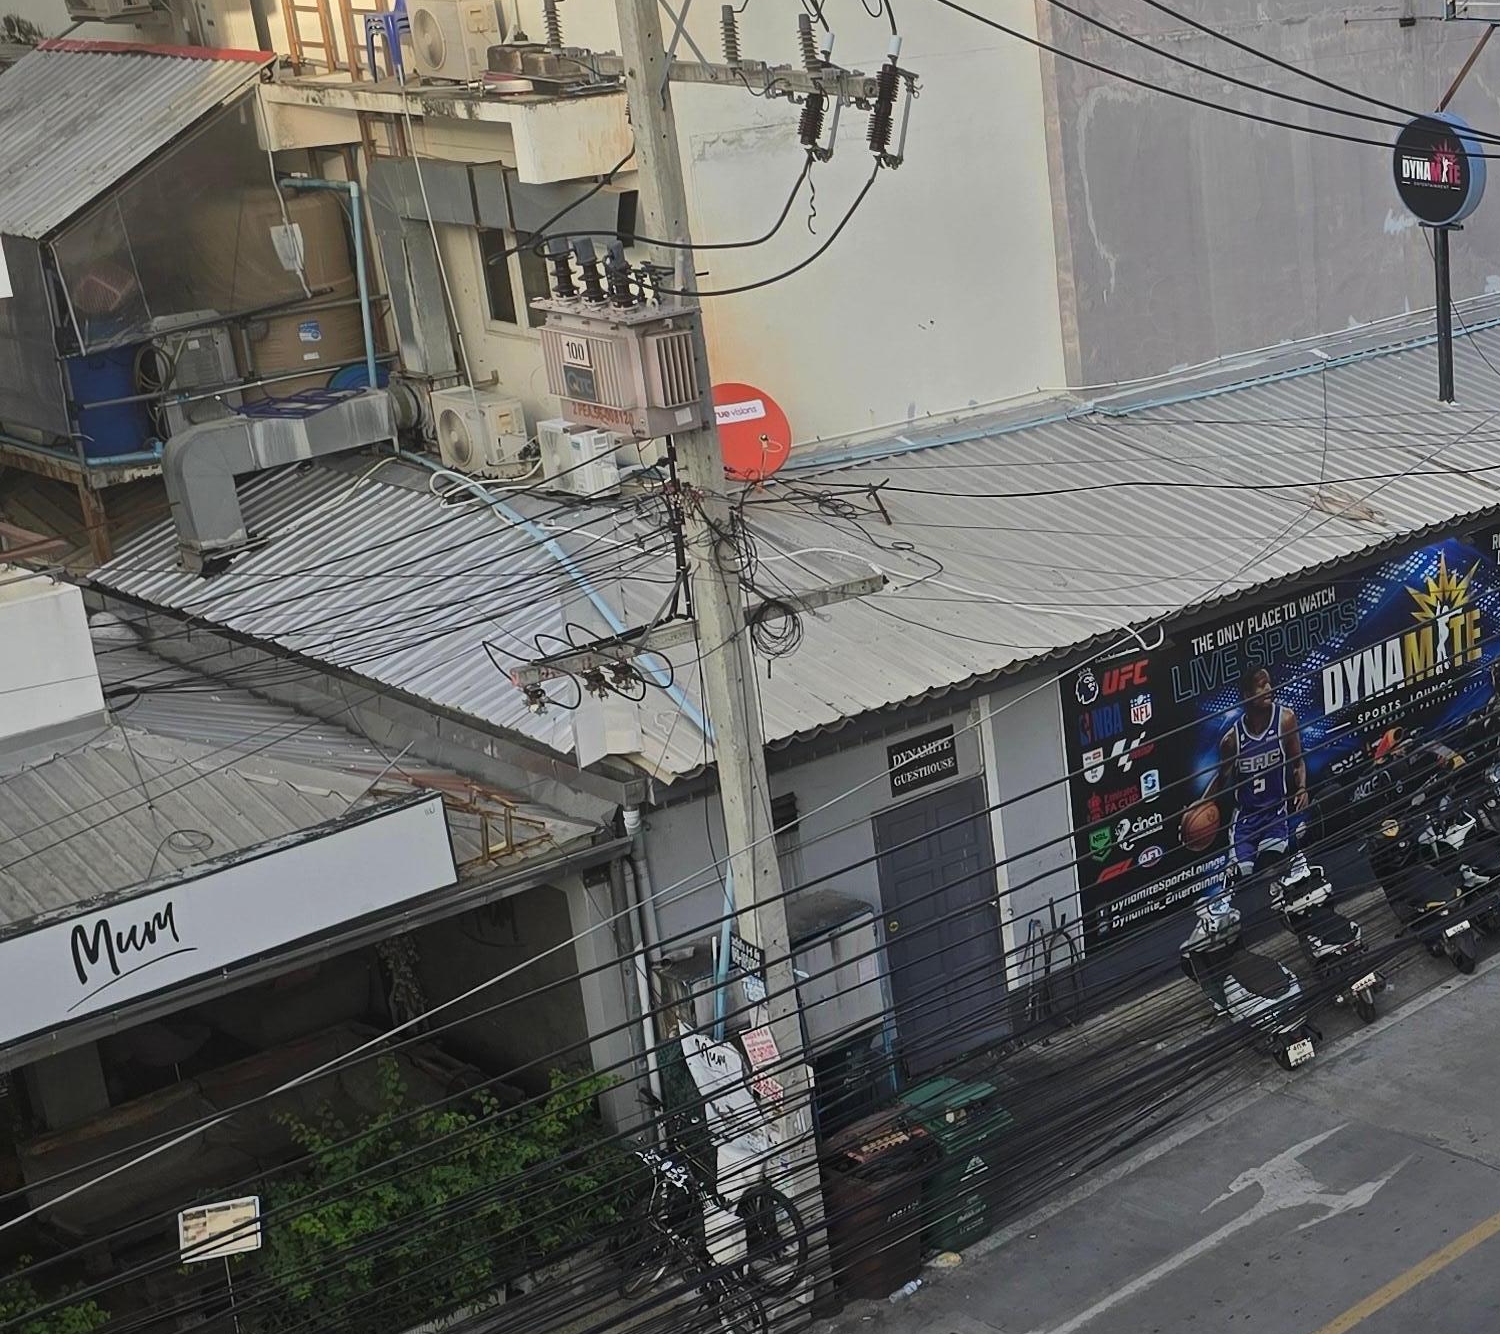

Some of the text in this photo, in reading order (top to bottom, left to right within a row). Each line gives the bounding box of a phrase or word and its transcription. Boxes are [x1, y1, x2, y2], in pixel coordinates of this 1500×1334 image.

[1401, 158, 1461, 185] DYNAMITE
[566, 340, 585, 361] 100
[1191, 586, 1337, 656] THE ONLY PLACE TO WATCH
[1171, 599, 1360, 704] LIVE SPORTS
[1322, 608, 1483, 716] DYNAMITE
[1102, 659, 1150, 696] UFC
[1132, 705, 1151, 723] NFL
[1357, 678, 1453, 724] SPORTS LOUNGE
[1092, 703, 1125, 741] NBA
[892, 739, 952, 767] DYNAMITE
[1239, 748, 1281, 773] SAC
[893, 756, 955, 787] GUESTHOUSE
[1131, 812, 1163, 834] cinch
[1141, 849, 1163, 865] AFL
